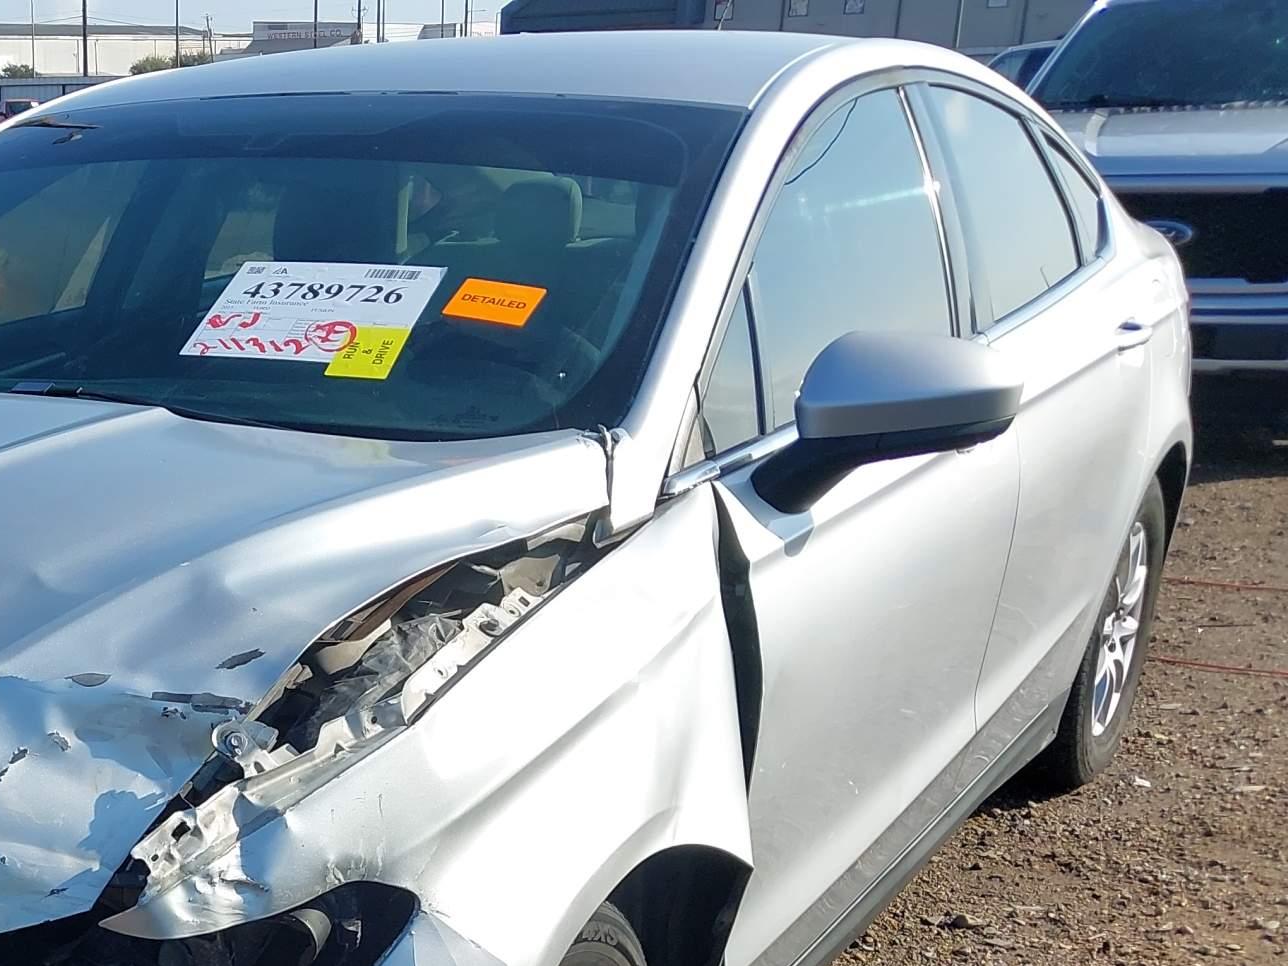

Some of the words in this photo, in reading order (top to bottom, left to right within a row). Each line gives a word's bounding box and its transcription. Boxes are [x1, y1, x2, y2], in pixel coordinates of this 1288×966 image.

[266, 31, 302, 40] WESTERN
[304, 30, 327, 39] STEL
[329, 28, 343, 38] CO.
[242, 281, 408, 305] 43789726
[461, 293, 527, 310] DETAILED
[343, 341, 360, 359] RUN
[372, 339, 394, 365] DRIVE
